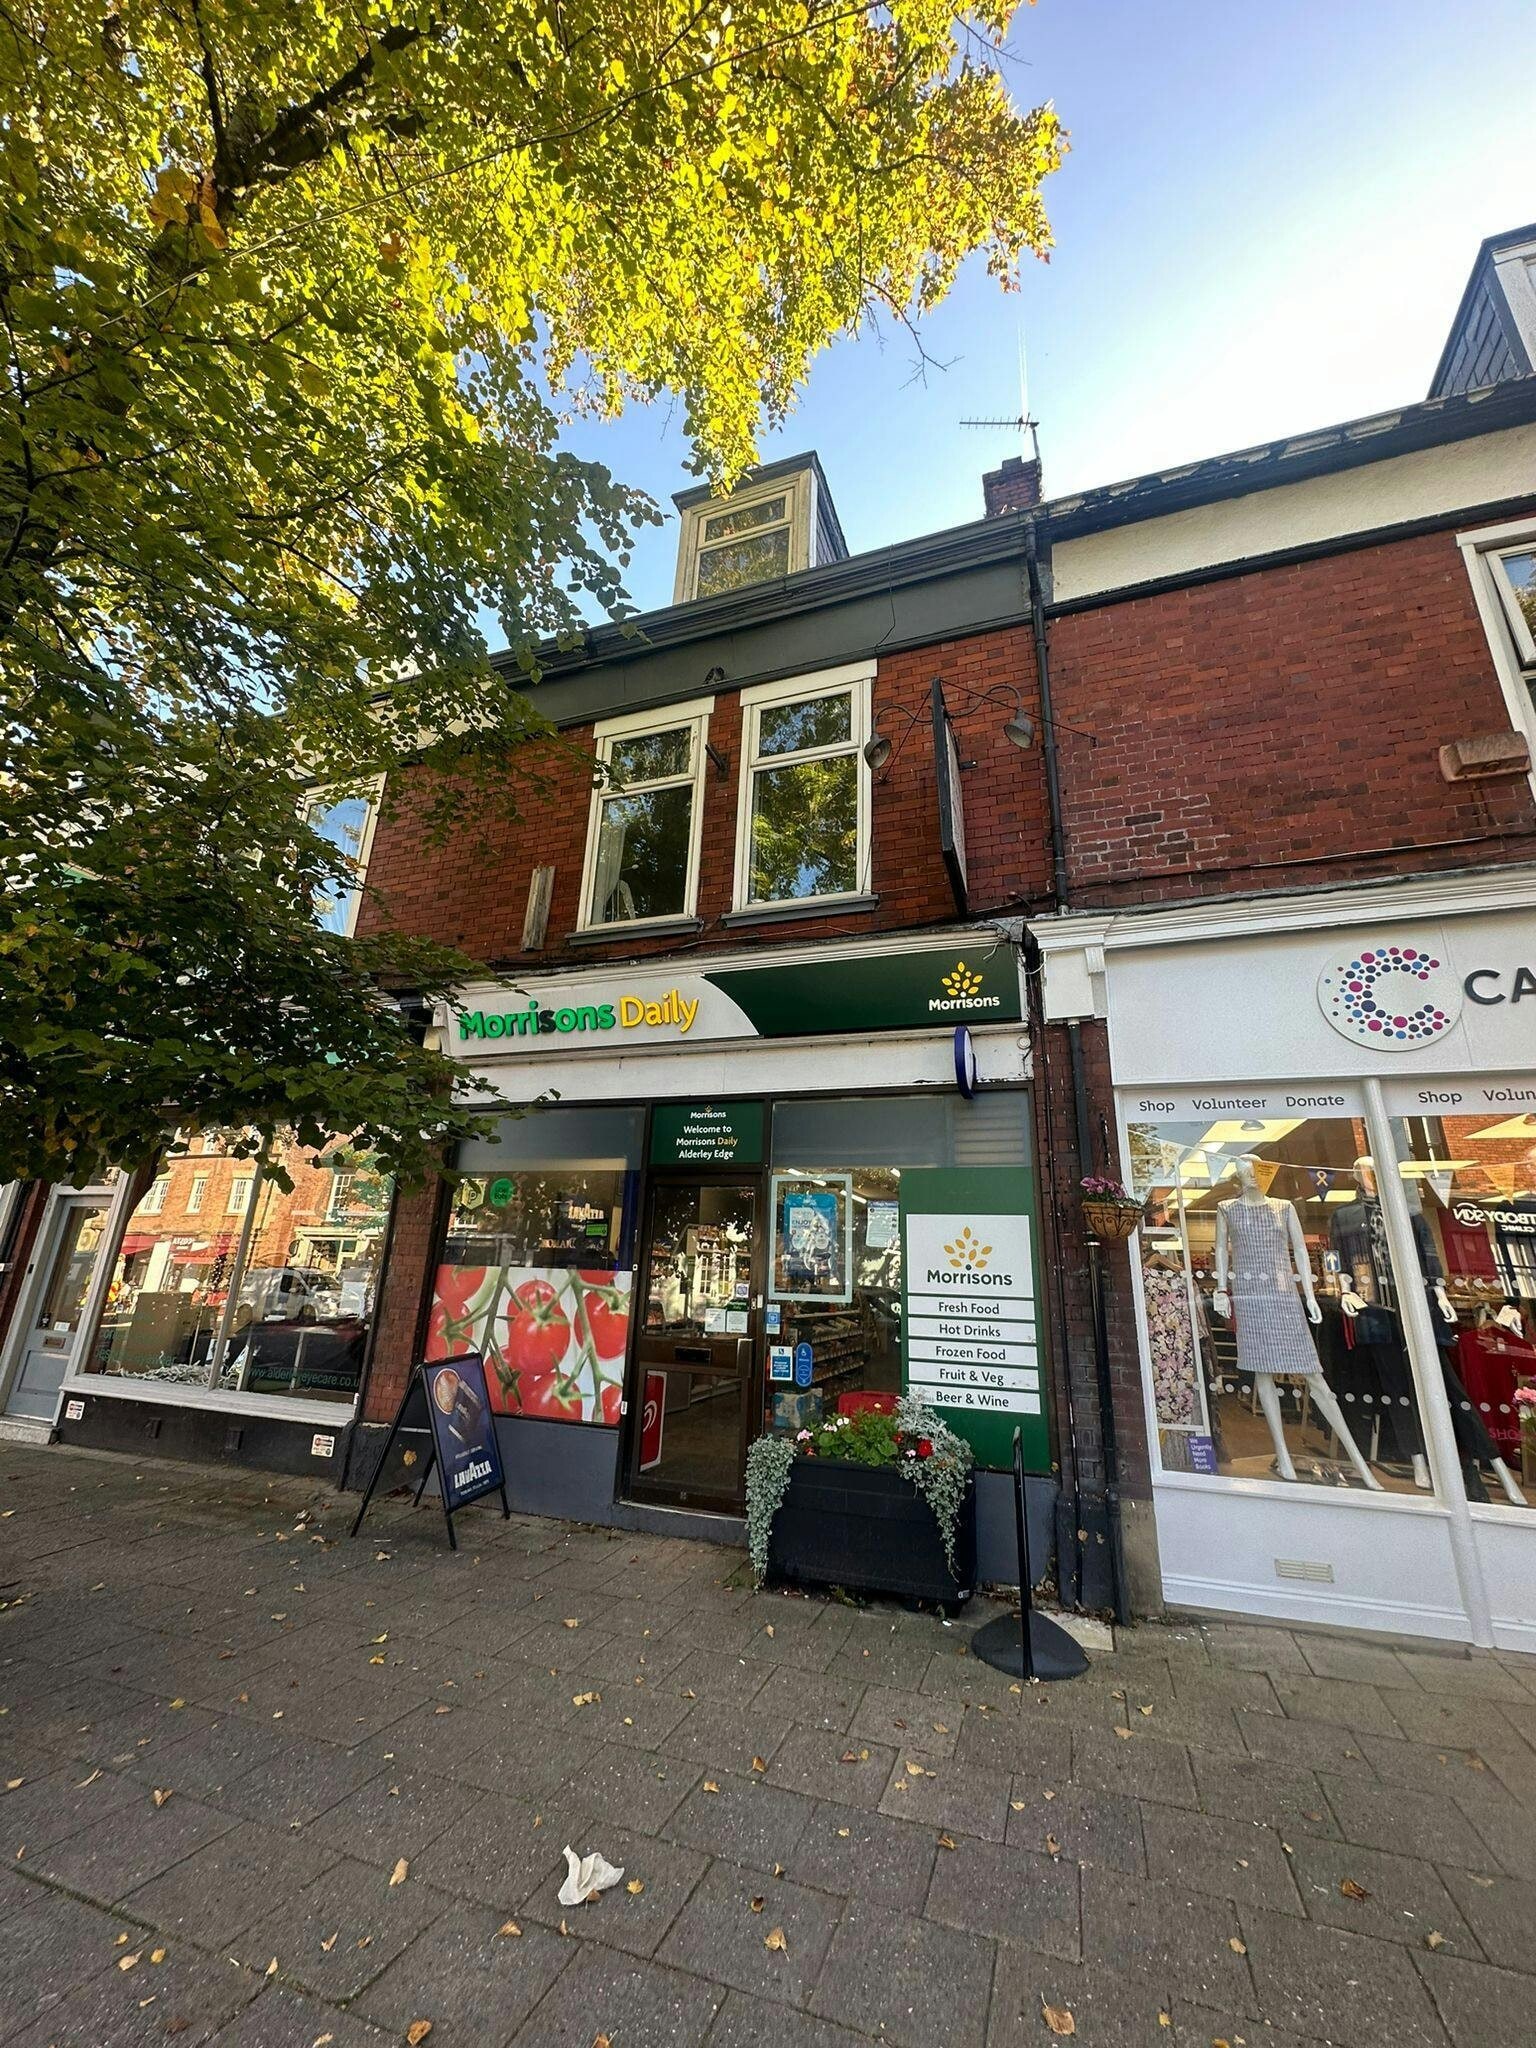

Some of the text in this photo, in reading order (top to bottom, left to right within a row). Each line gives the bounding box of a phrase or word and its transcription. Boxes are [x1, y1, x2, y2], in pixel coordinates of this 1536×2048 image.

[928, 992, 1001, 1011] Morrisons
[459, 987, 700, 1041] Morrisons Daily
[1139, 1095, 1345, 1114] Shop Volunteer Donate
[1418, 1090, 1463, 1105] Shop
[690, 1111, 727, 1119] Morrisons
[683, 1125, 732, 1134] Welcome to
[676, 1136, 738, 1147] Morrisons Daily
[679, 1149, 734, 1160] Alderley Edge
[927, 1264, 1013, 1286] Morrisons
[938, 1301, 1000, 1315] Fresh Food
[939, 1324, 1001, 1338] Hot Drinks
[936, 1346, 1006, 1360] Frozen Food
[939, 1368, 1004, 1387] Fruit & Veg
[936, 1391, 1009, 1408] Beer & Wine
[454, 1460, 493, 1489] LAVAZZA
